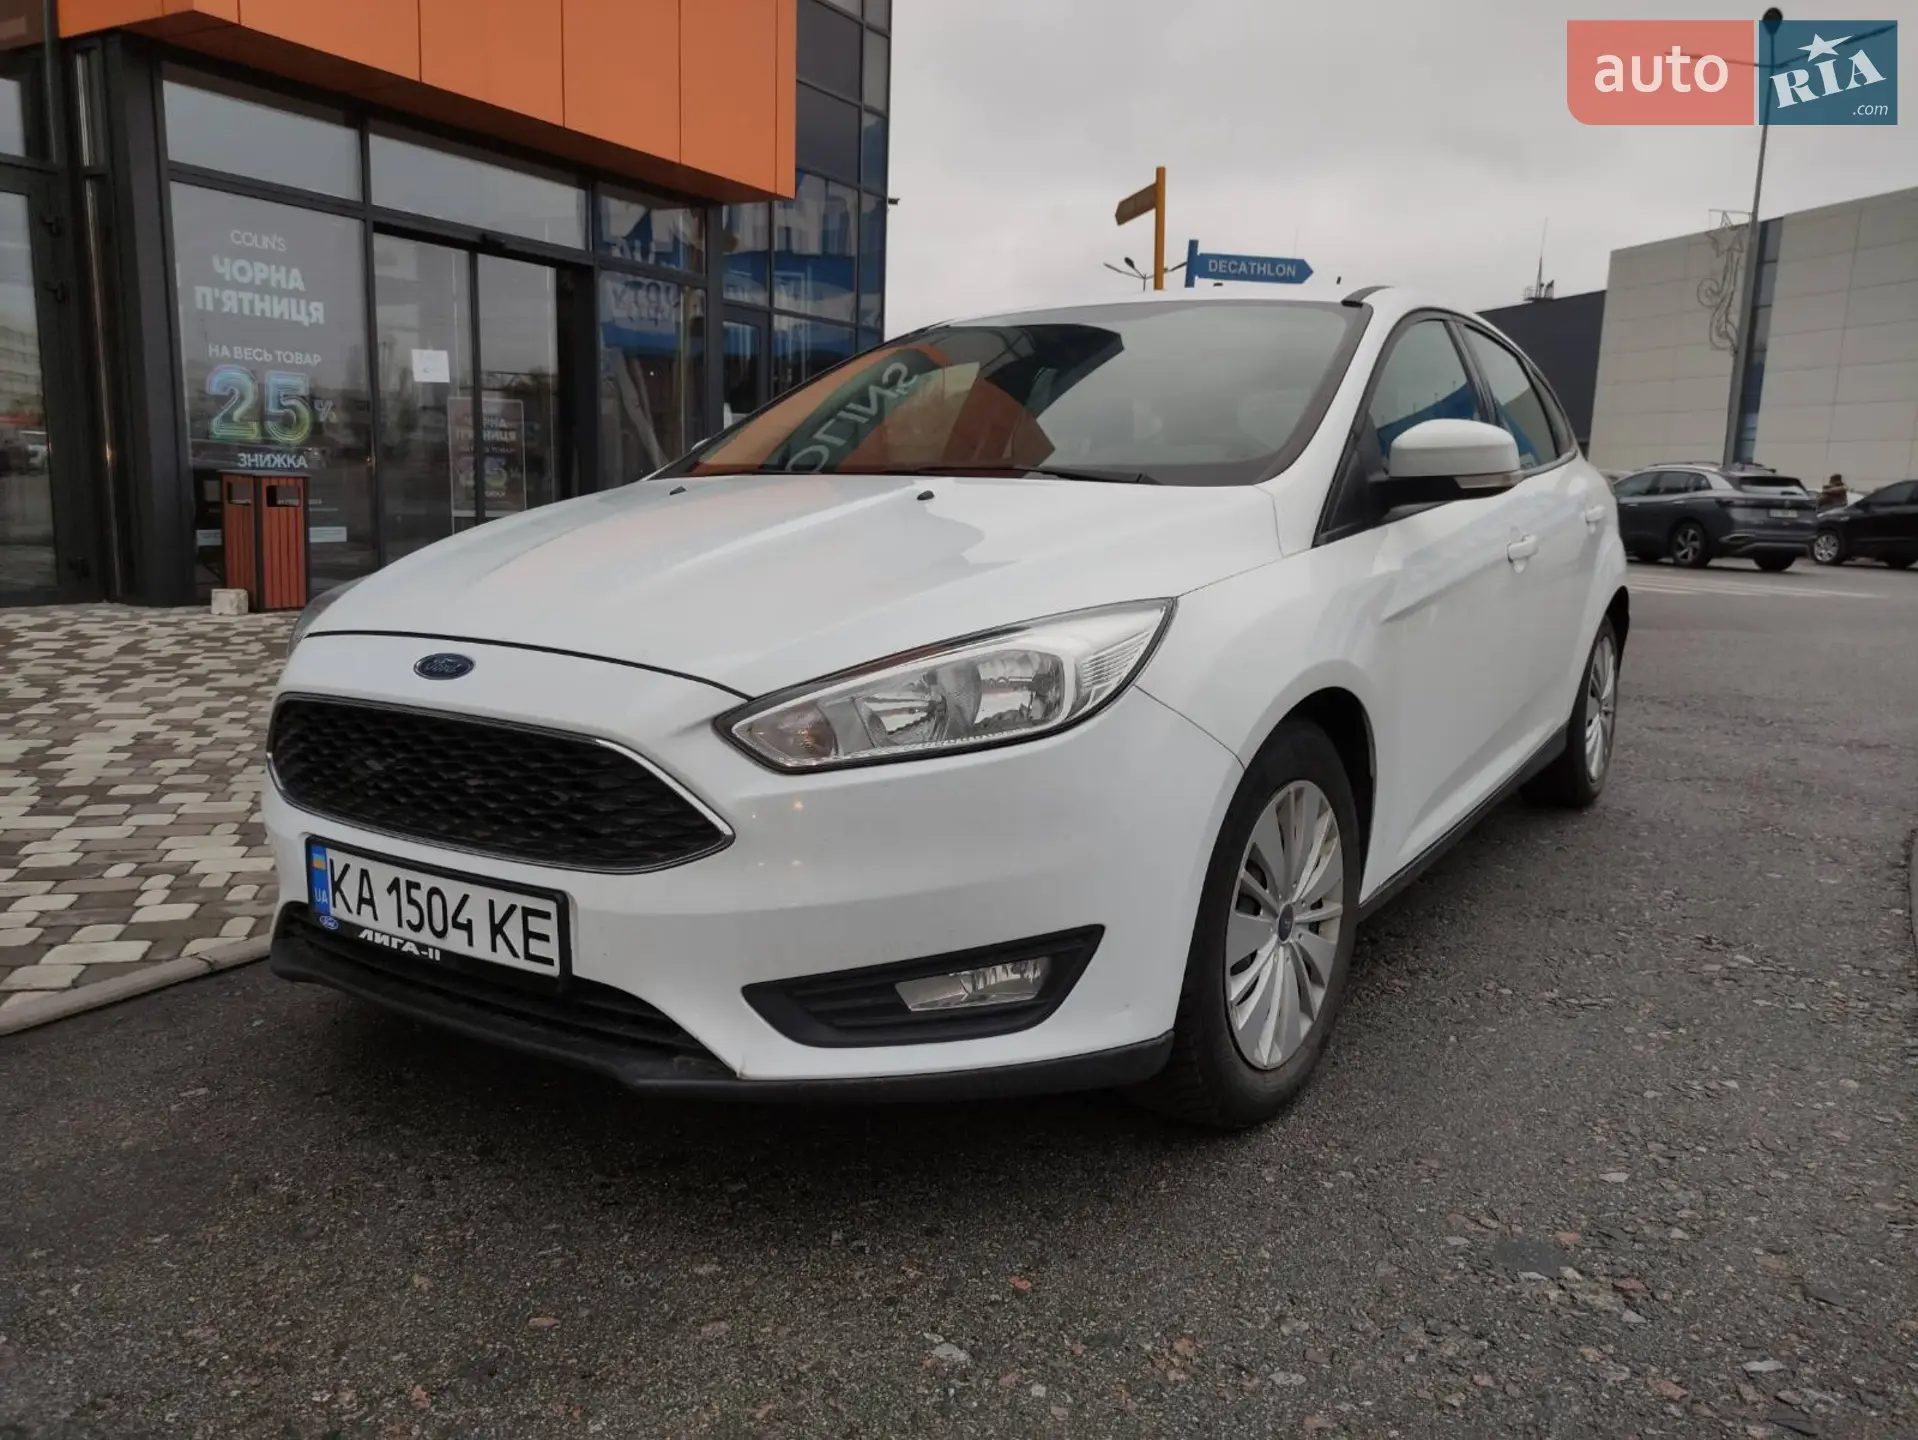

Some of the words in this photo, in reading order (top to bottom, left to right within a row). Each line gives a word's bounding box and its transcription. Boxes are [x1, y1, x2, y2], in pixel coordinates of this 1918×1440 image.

[230, 229, 287, 252] COLIN'S
[212, 254, 306, 292] ЧОРНА
[1208, 259, 1296, 277] DECATHLON
[194, 285, 325, 327] П'ЯТНИЦЯ
[208, 343, 231, 359] НА
[233, 346, 273, 363] ВЕСЬ
[274, 350, 321, 368] ТОВАР
[237, 452, 308, 469] ЗНИЖКА
[314, 886, 328, 904] UA
[329, 858, 378, 922] KA
[386, 876, 474, 948] 1504
[488, 898, 555, 966] KE
